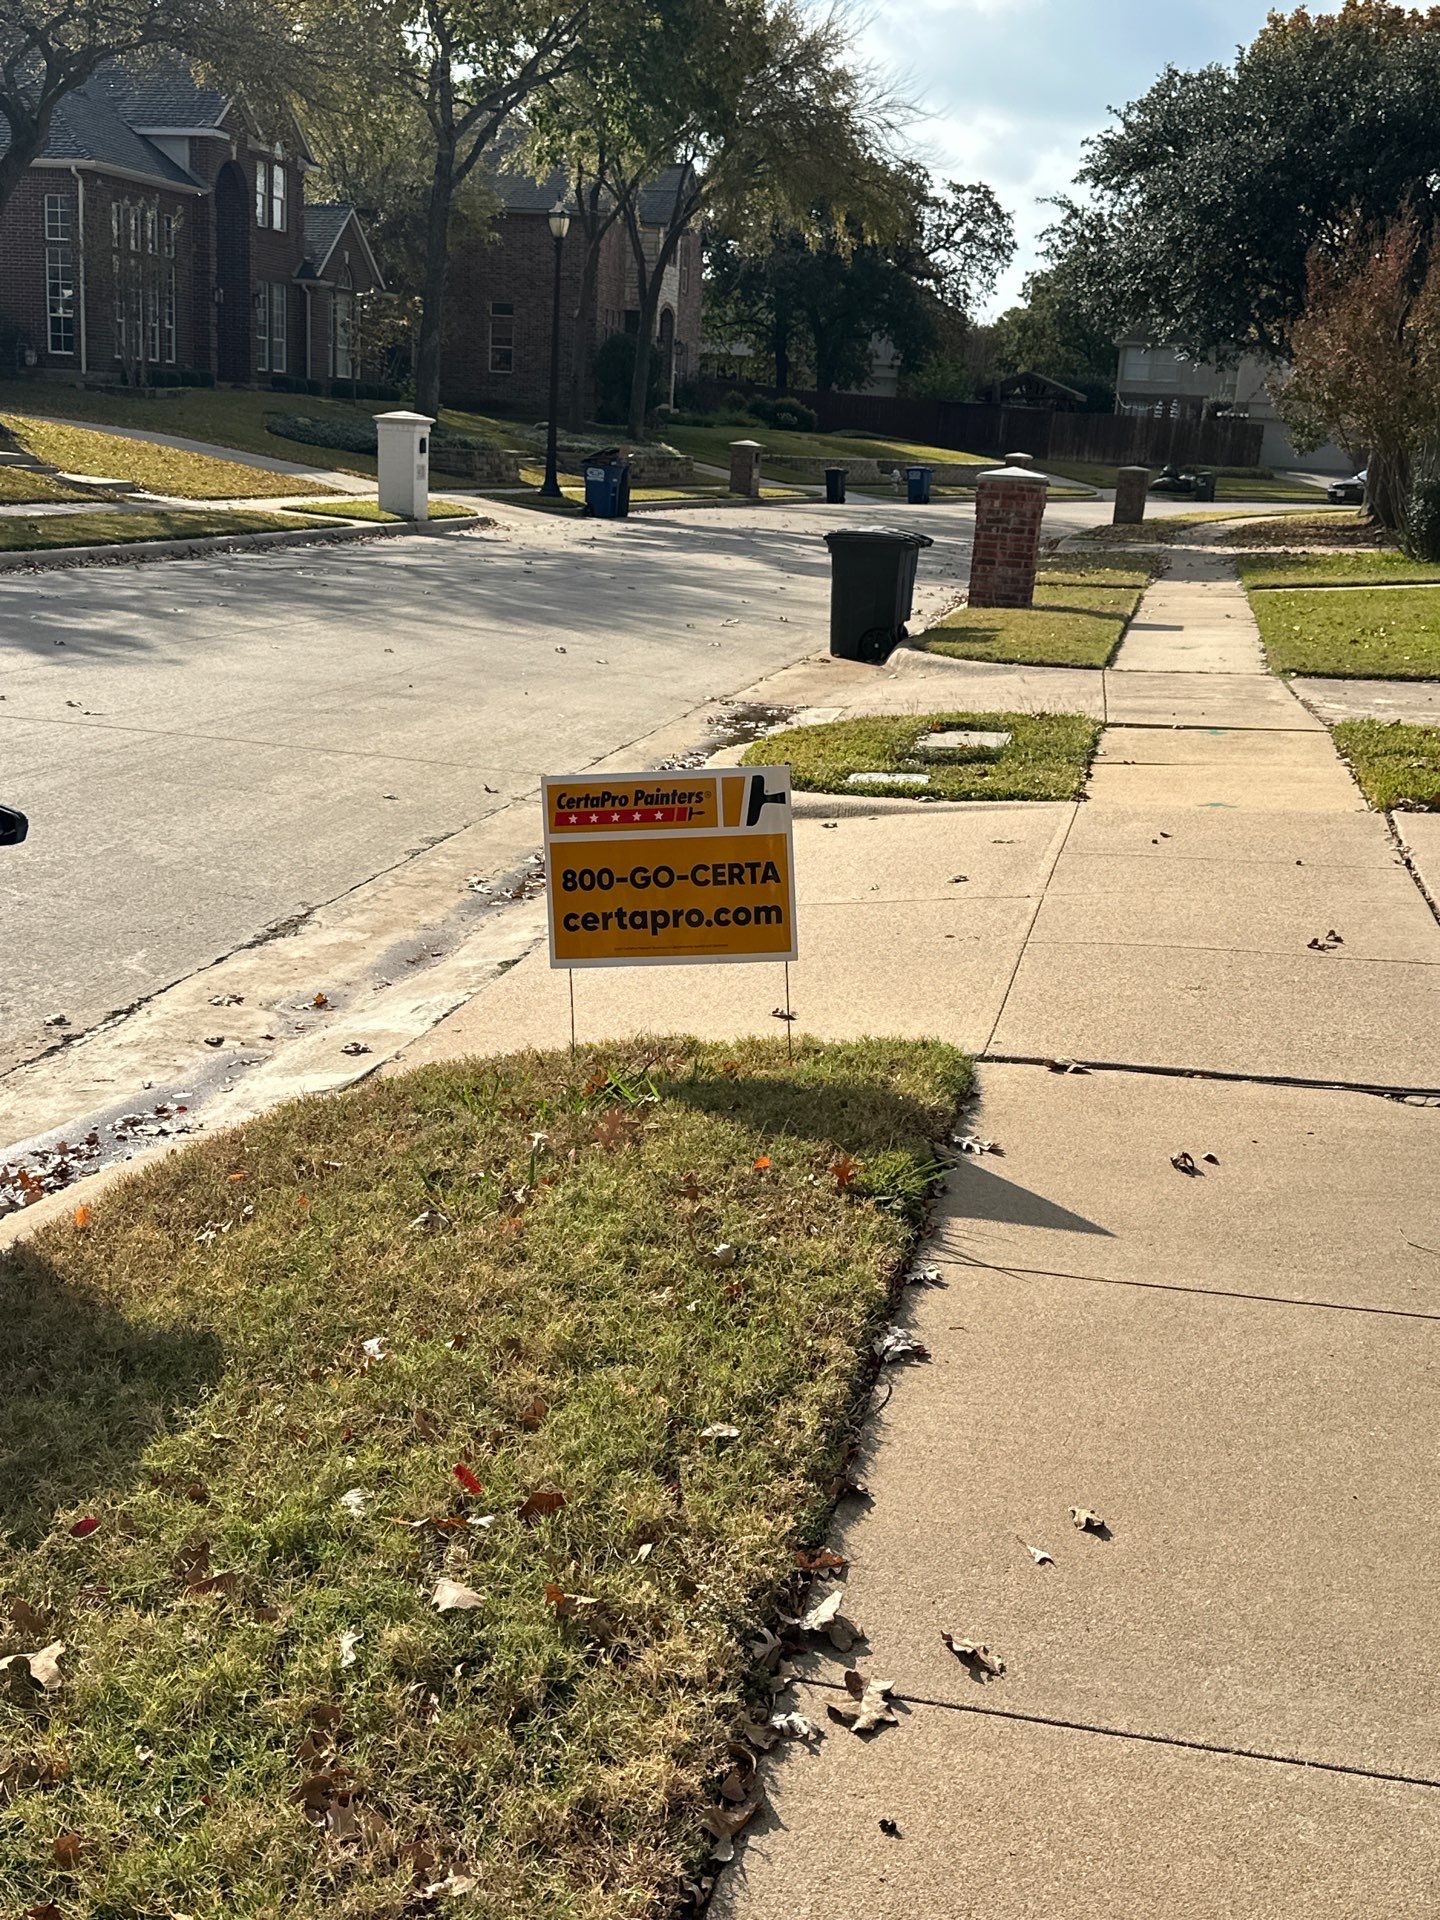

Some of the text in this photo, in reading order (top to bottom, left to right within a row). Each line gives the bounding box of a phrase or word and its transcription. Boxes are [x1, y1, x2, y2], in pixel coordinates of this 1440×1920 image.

[556, 790, 629, 810] CertaPro
[561, 861, 781, 892] 800-GO-CERTA
[562, 904, 783, 936] certapro.com
